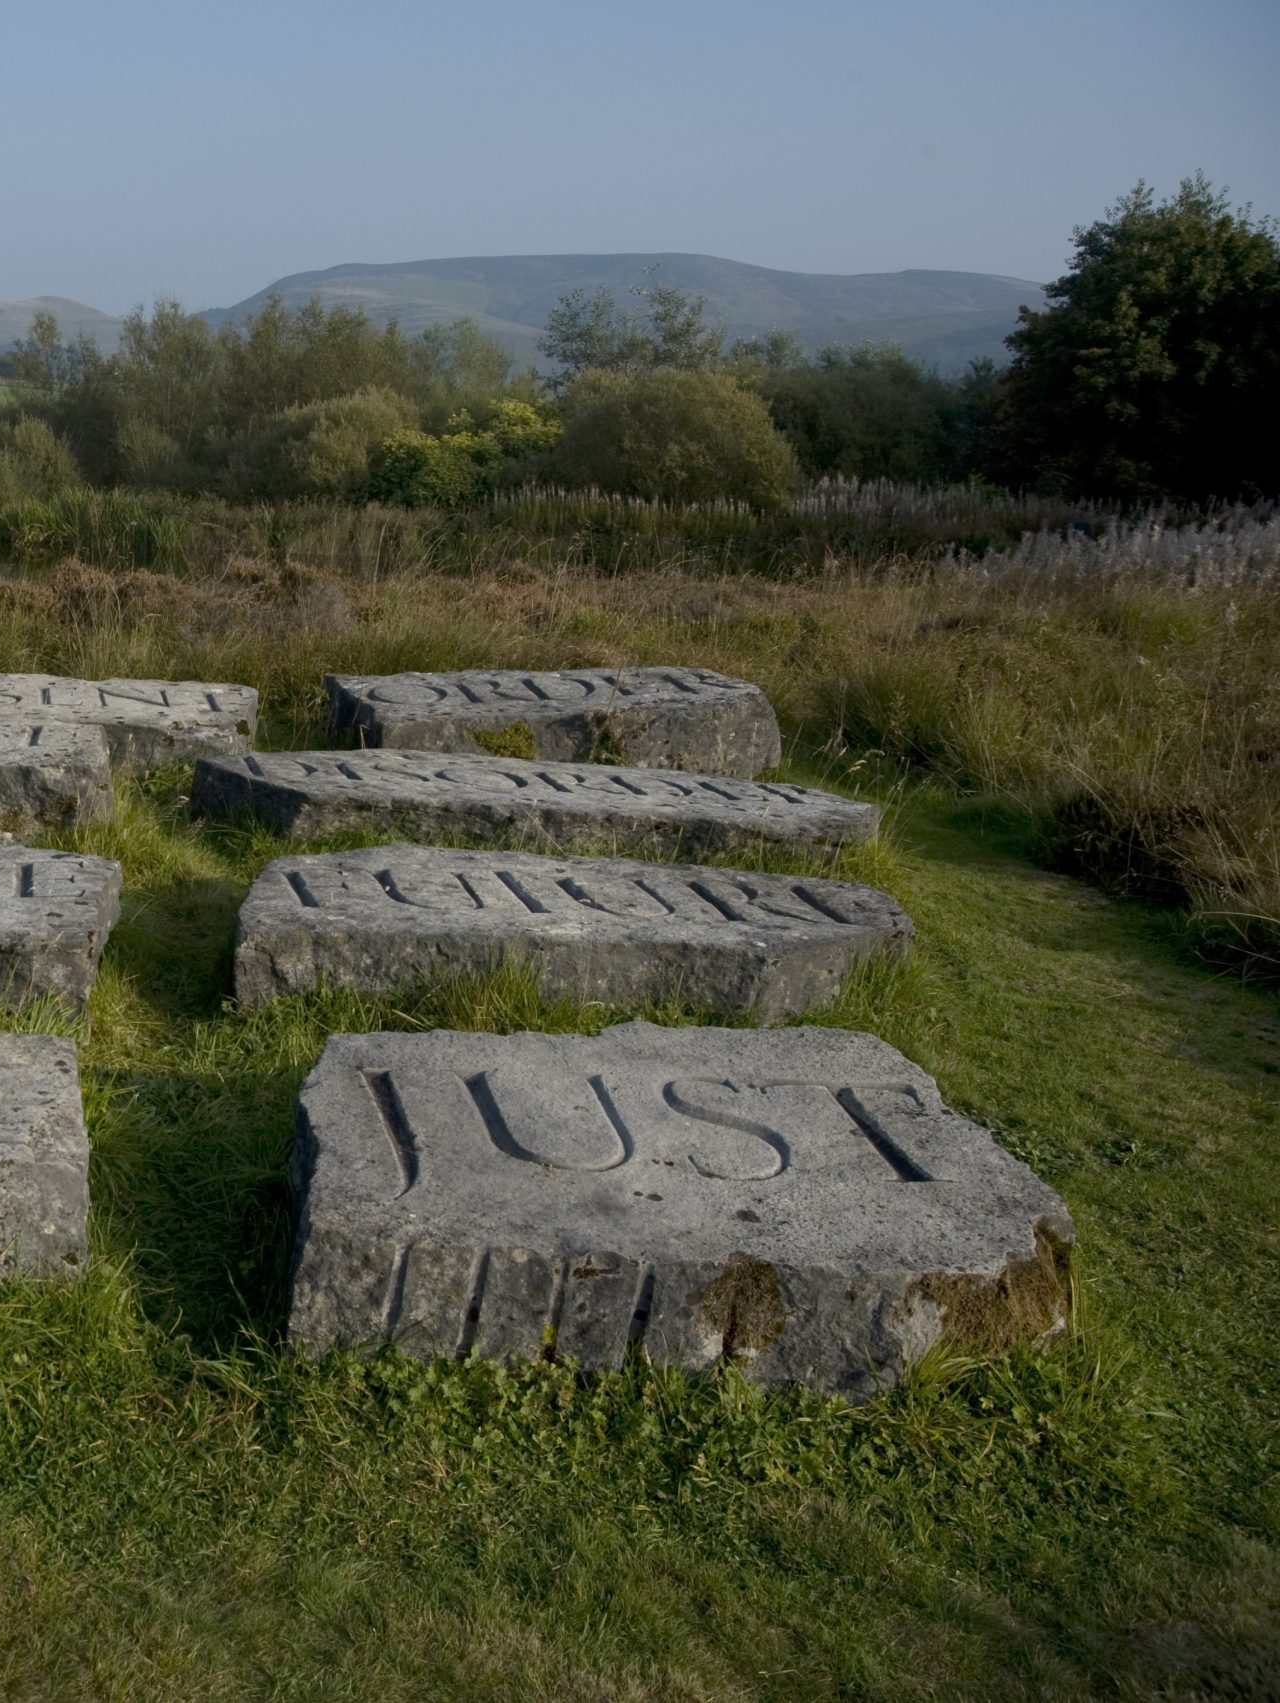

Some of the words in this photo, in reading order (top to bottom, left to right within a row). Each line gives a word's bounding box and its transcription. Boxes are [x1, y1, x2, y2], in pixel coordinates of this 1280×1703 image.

[368, 671, 738, 704] ORDER
[238, 754, 818, 806] DISORDER
[280, 869, 898, 926] FUTURE
[356, 1064, 956, 1200] JUST
